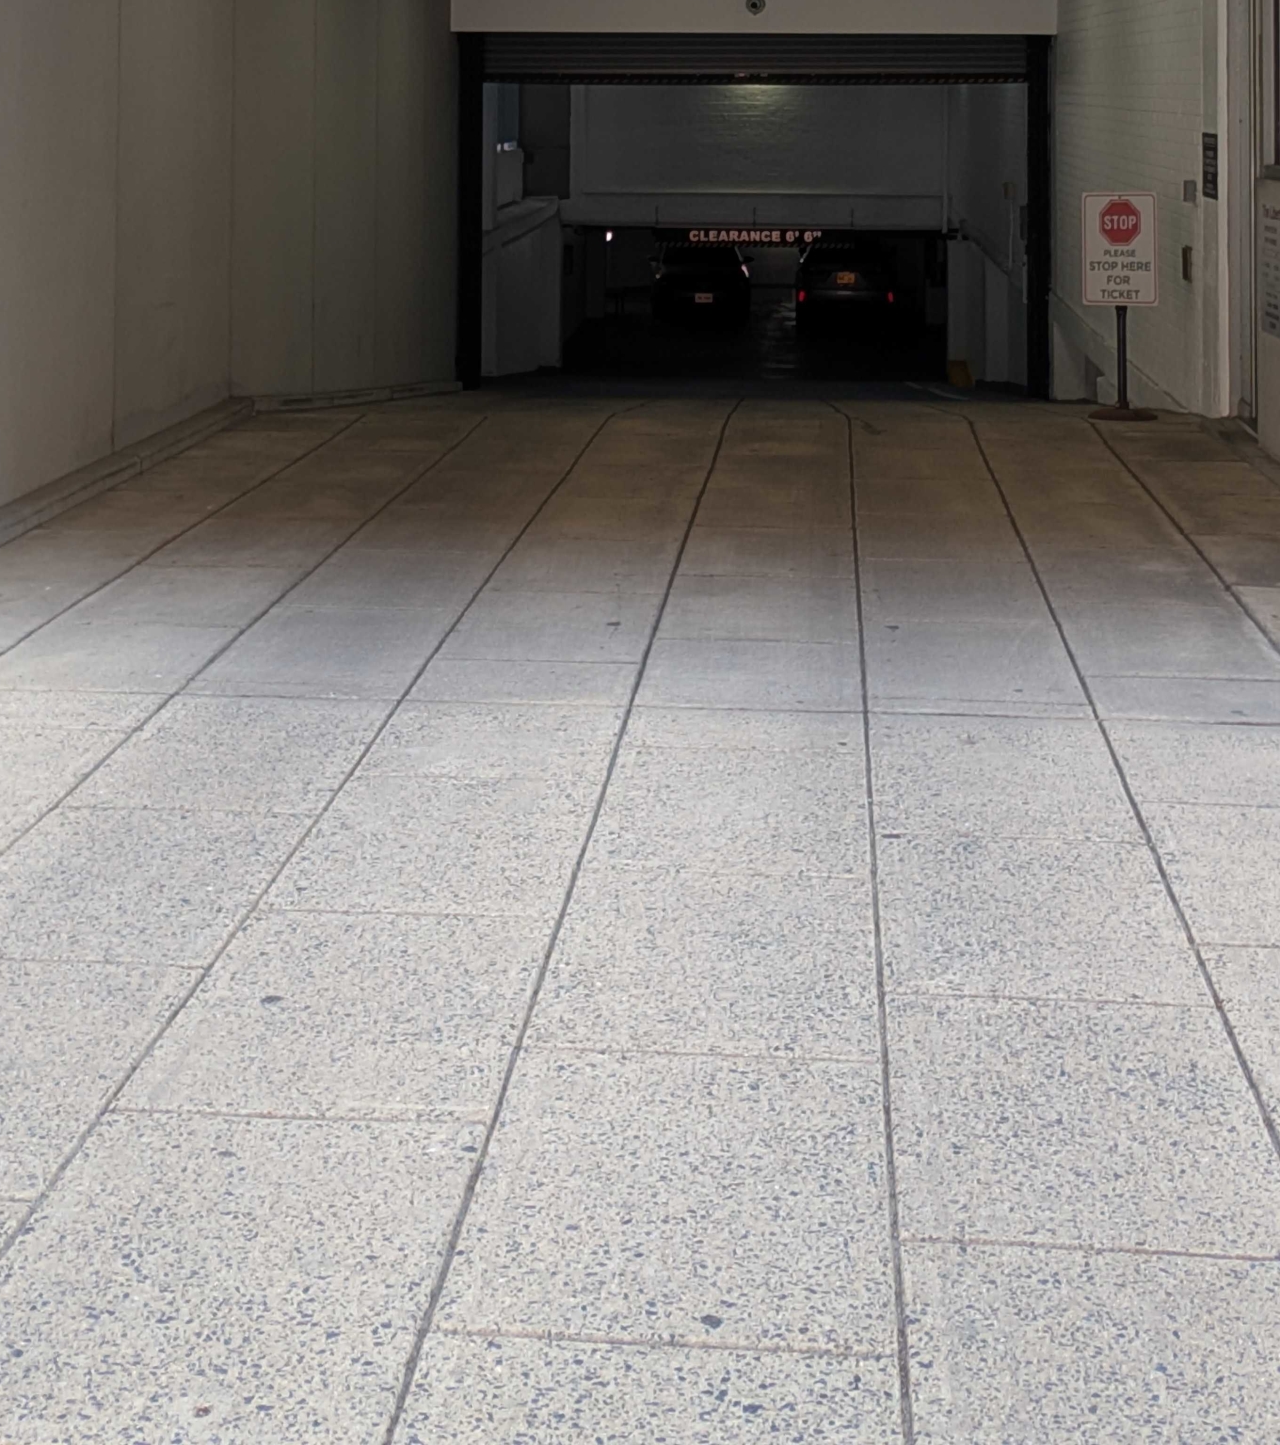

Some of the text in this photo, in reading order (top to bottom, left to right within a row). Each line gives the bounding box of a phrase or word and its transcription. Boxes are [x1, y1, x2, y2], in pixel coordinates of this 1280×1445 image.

[1103, 215, 1137, 230] STOP
[689, 230, 822, 242] CLEARANCE 6' 6"
[1103, 249, 1136, 258] PLEASE
[1089, 261, 1151, 272] STOP HERE
[1106, 275, 1131, 285] FOR
[1100, 289, 1140, 300] TICKET
